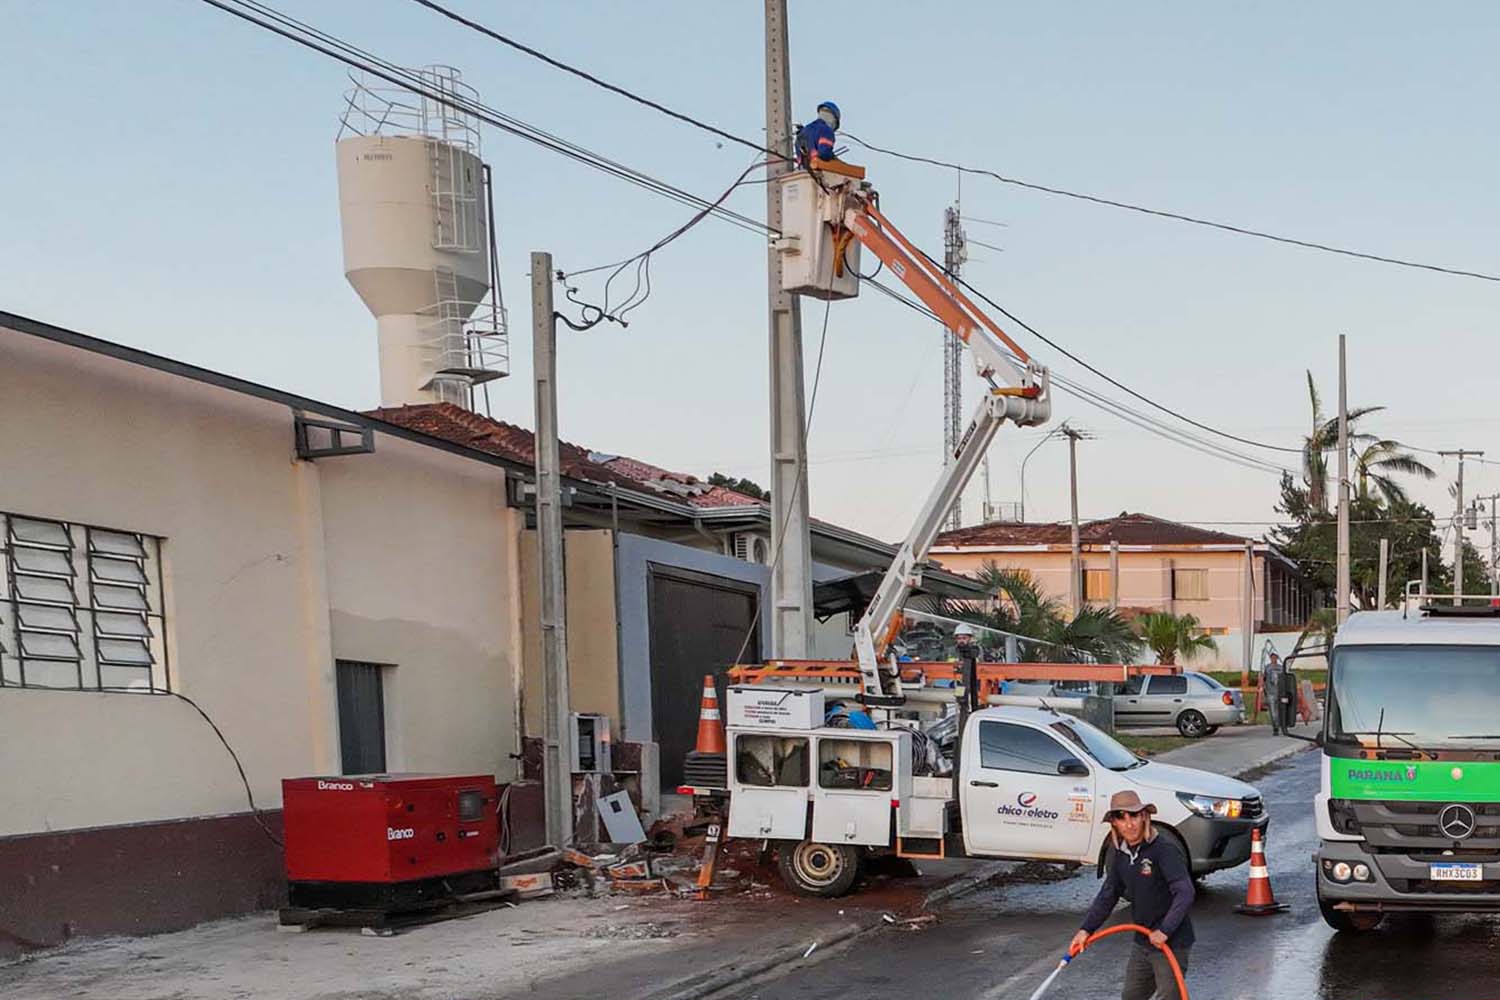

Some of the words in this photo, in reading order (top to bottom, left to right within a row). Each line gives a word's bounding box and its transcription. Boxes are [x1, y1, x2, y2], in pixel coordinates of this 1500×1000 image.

[318, 780, 354, 791] Branco
[997, 804, 1023, 816] chico
[1027, 808, 1059, 820] eletro
[387, 827, 414, 841] Branco
